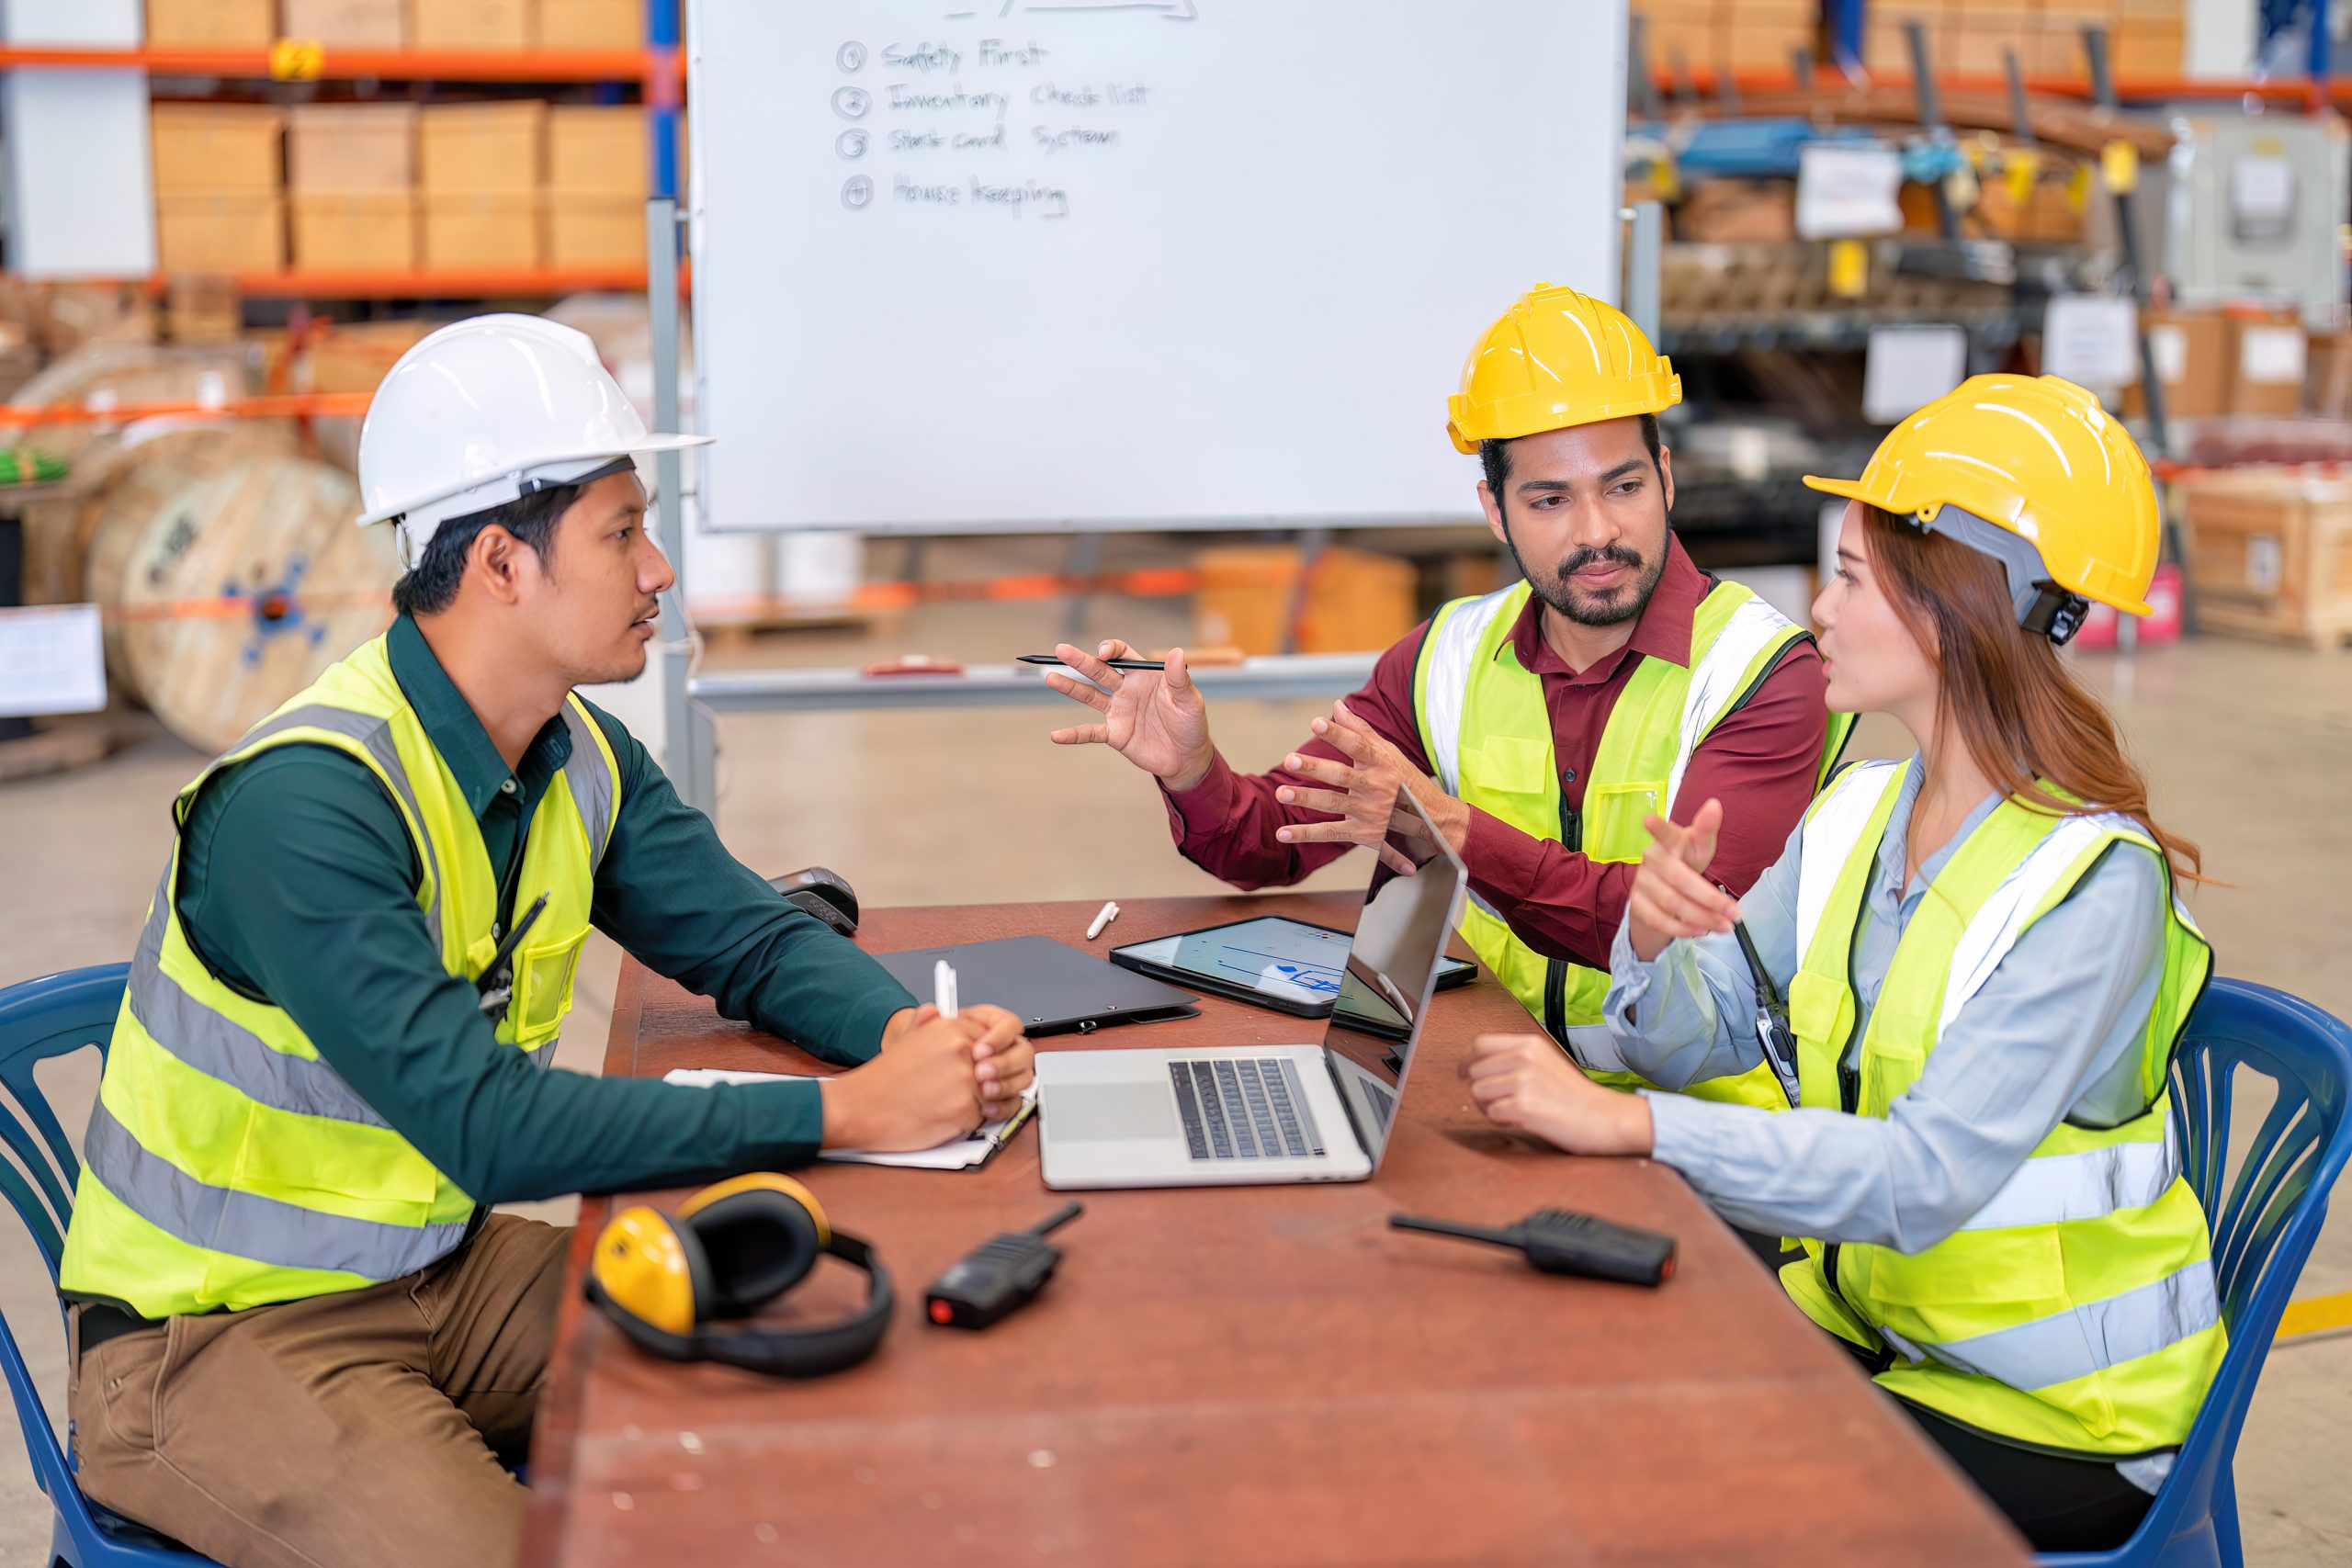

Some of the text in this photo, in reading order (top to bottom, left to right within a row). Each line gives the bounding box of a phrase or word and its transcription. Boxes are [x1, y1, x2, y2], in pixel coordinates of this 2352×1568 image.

[881, 41, 961, 74] Safety
[979, 39, 1050, 67] First
[885, 83, 1010, 121] Inventory
[893, 174, 961, 206] House
